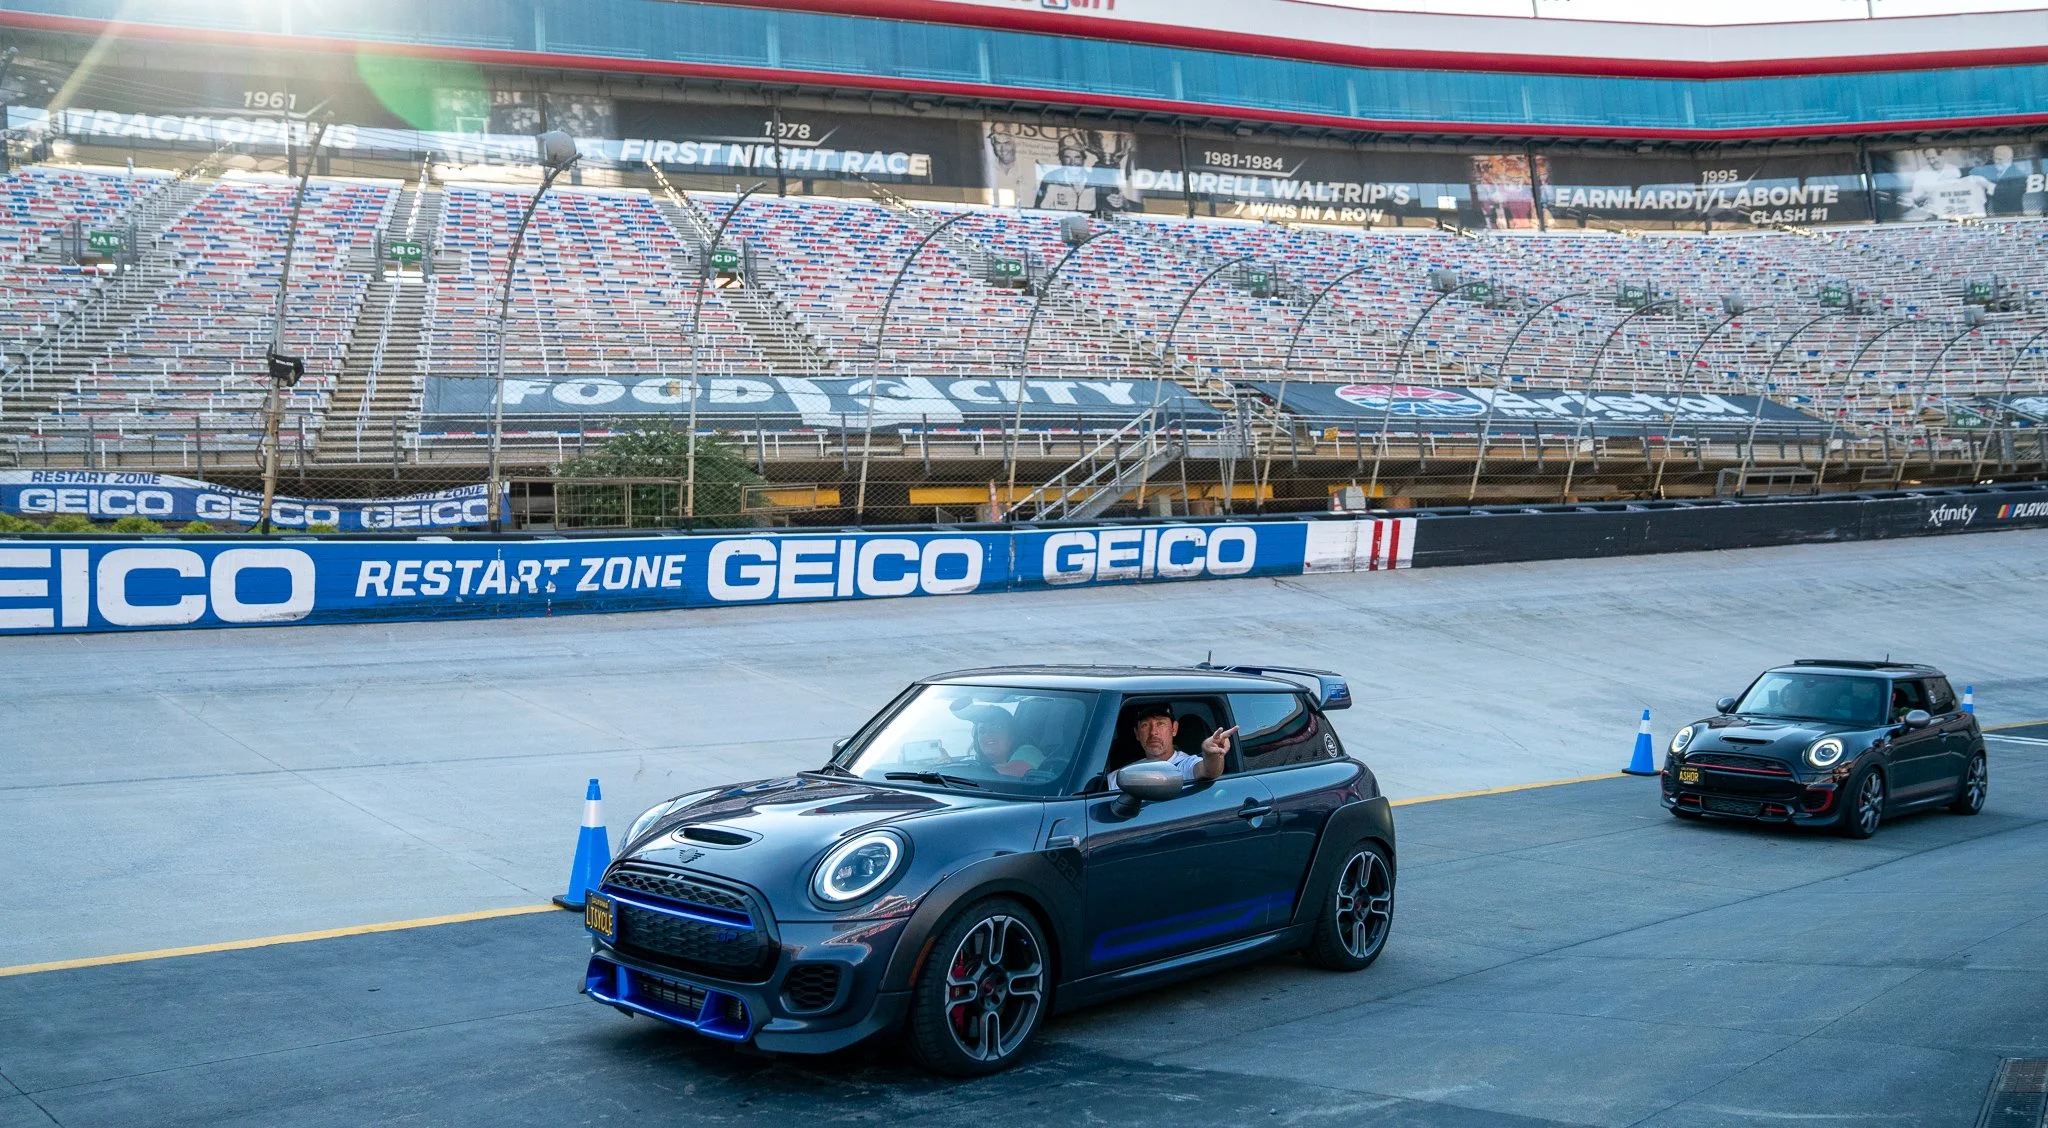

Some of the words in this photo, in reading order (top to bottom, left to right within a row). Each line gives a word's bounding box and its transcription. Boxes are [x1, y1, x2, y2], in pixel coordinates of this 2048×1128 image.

[244, 91, 297, 109] 1961
[66, 107, 213, 141] TRACK
[764, 121, 810, 139] 1978
[620, 138, 721, 165] FIRST
[727, 143, 835, 171] NIGHT
[841, 151, 932, 177] RACE
[1204, 151, 1283, 170] 1981-1984
[1131, 169, 1263, 196] DARRELL
[1271, 178, 1411, 205] WALTRIP'S
[1702, 170, 1738, 184] 1995
[2026, 173, 2048, 193] B
[1234, 201, 1245, 215] 7
[1249, 203, 1298, 219] WINS
[1301, 205, 1320, 220] IN
[1322, 206, 1337, 221] A
[1340, 207, 1384, 223] ROW
[1750, 208, 1807, 224] CLASH
[1810, 207, 1828, 221] #1
[492, 378, 775, 405] FOOD
[948, 379, 1136, 405] CITY
[31, 471, 109, 484] RESTART
[114, 473, 161, 485] ZONE
[19, 488, 174, 514] GEICO
[196, 493, 340, 526] GECO
[360, 498, 488, 529] GEICO
[1928, 503, 1977, 527] xfinity
[1043, 526, 1257, 585] GEICO
[354, 558, 571, 597] RESTART
[575, 554, 687, 592] ZONE
[708, 538, 984, 602] GEICO
[1679, 771, 1699, 782] ASHOR
